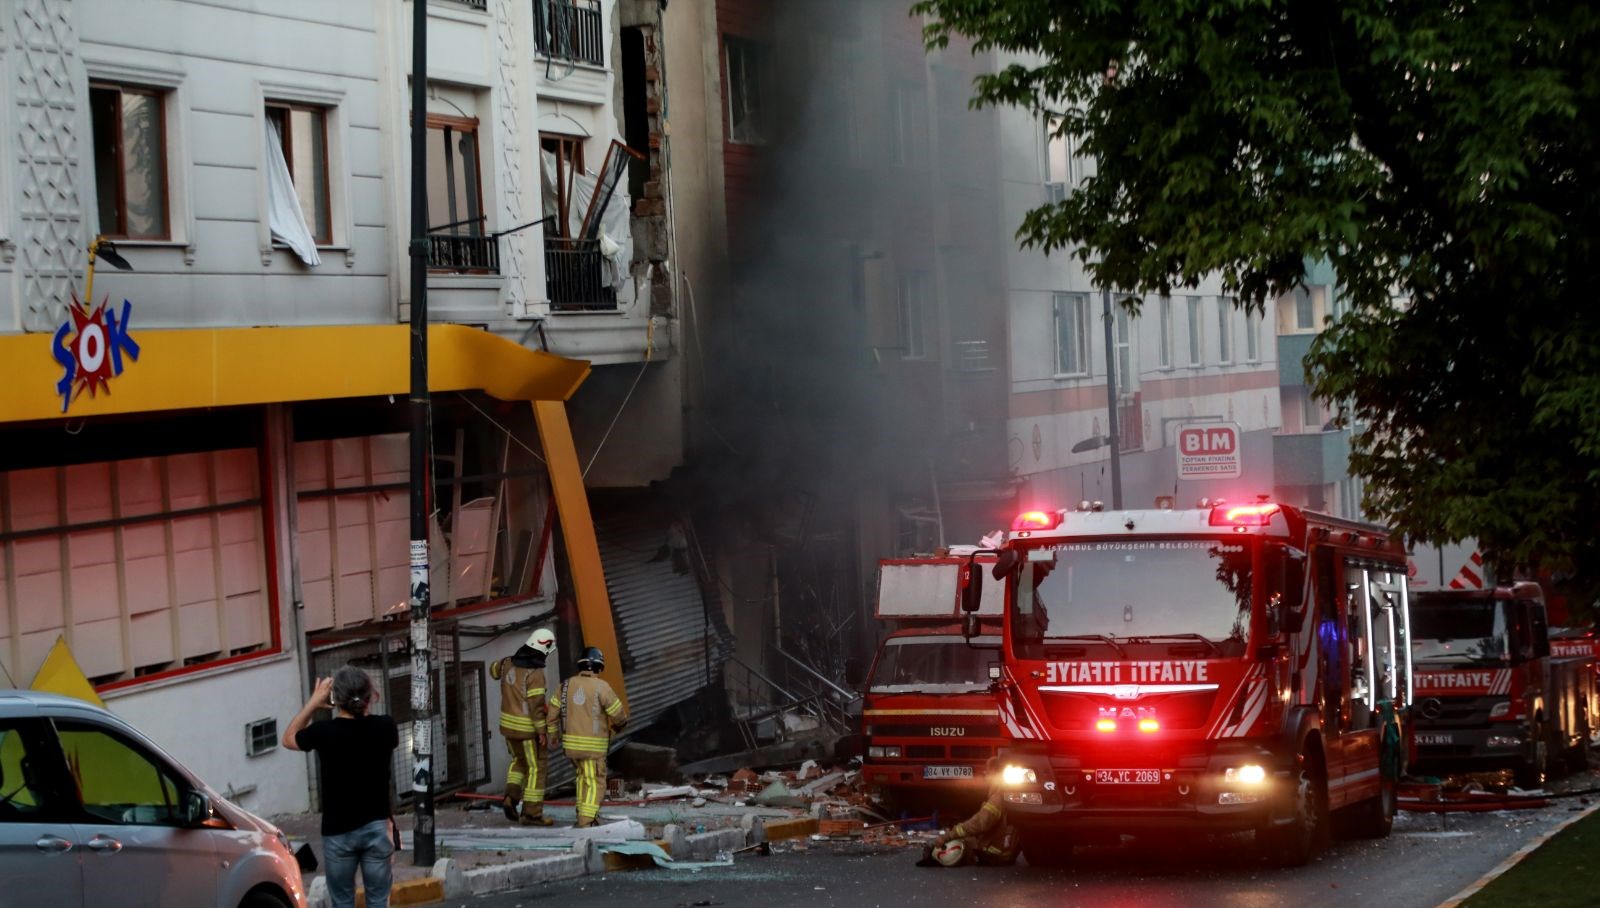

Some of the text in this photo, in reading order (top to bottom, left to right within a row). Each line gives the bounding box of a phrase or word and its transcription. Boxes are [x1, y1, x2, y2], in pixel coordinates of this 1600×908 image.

[52, 298, 140, 413] ŞOK
[1096, 542, 1156, 551] BÜYÜKŞEHİR
[1098, 707, 1156, 719] MAN
[930, 727, 965, 736] ISUZU
[928, 767, 937, 777] 34
[1101, 770, 1159, 783] 34 YC 2069
